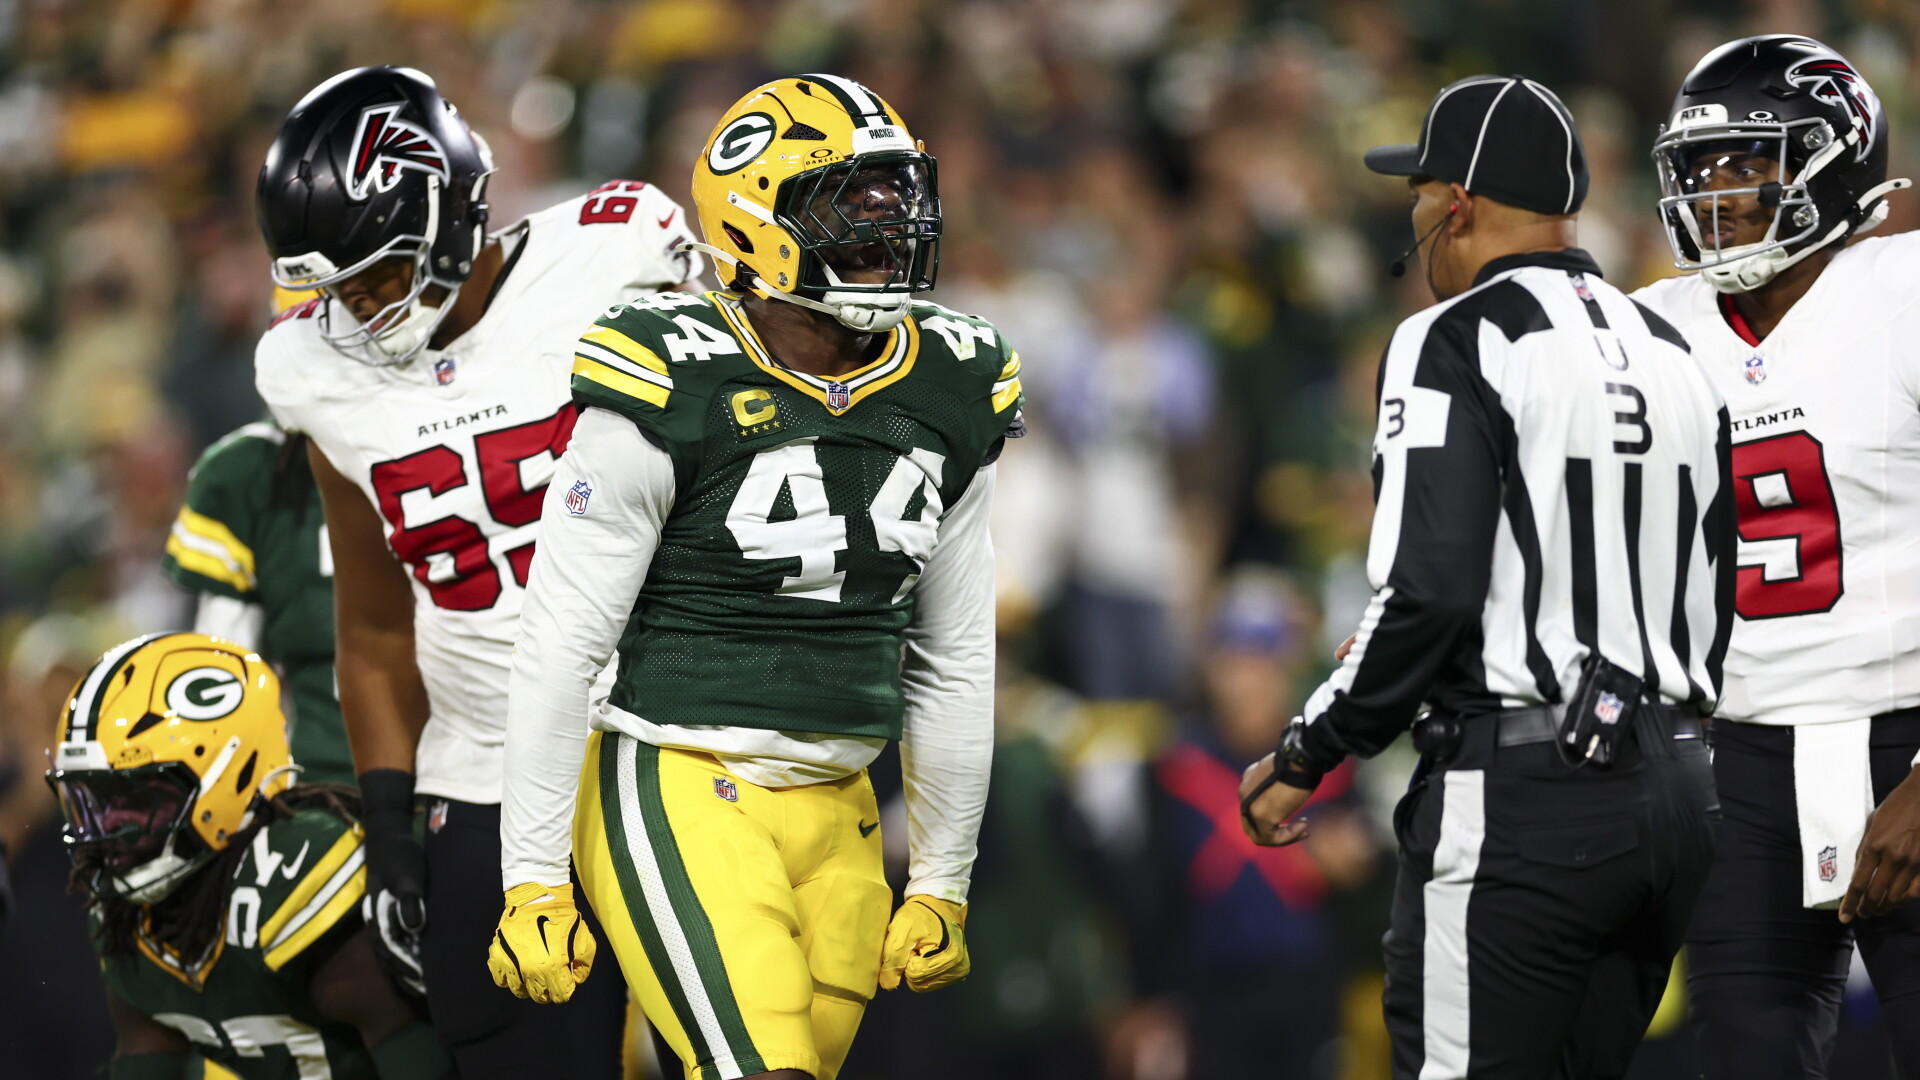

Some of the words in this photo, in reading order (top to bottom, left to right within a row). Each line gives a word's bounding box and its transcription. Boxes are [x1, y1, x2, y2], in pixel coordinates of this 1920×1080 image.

[1680, 107, 1710, 121] ATL
[709, 113, 776, 175] G
[805, 156, 840, 165] OAKLEY
[1594, 334, 1629, 371] U
[417, 404, 508, 437] ATLANTA
[732, 388, 776, 427] C
[1384, 397, 1406, 440] 3
[1605, 382, 1653, 455] 3
[1731, 407, 1805, 431] TLANTA
[725, 436, 946, 604] 44
[1731, 429, 1844, 621] 9
[164, 667, 244, 720] G
